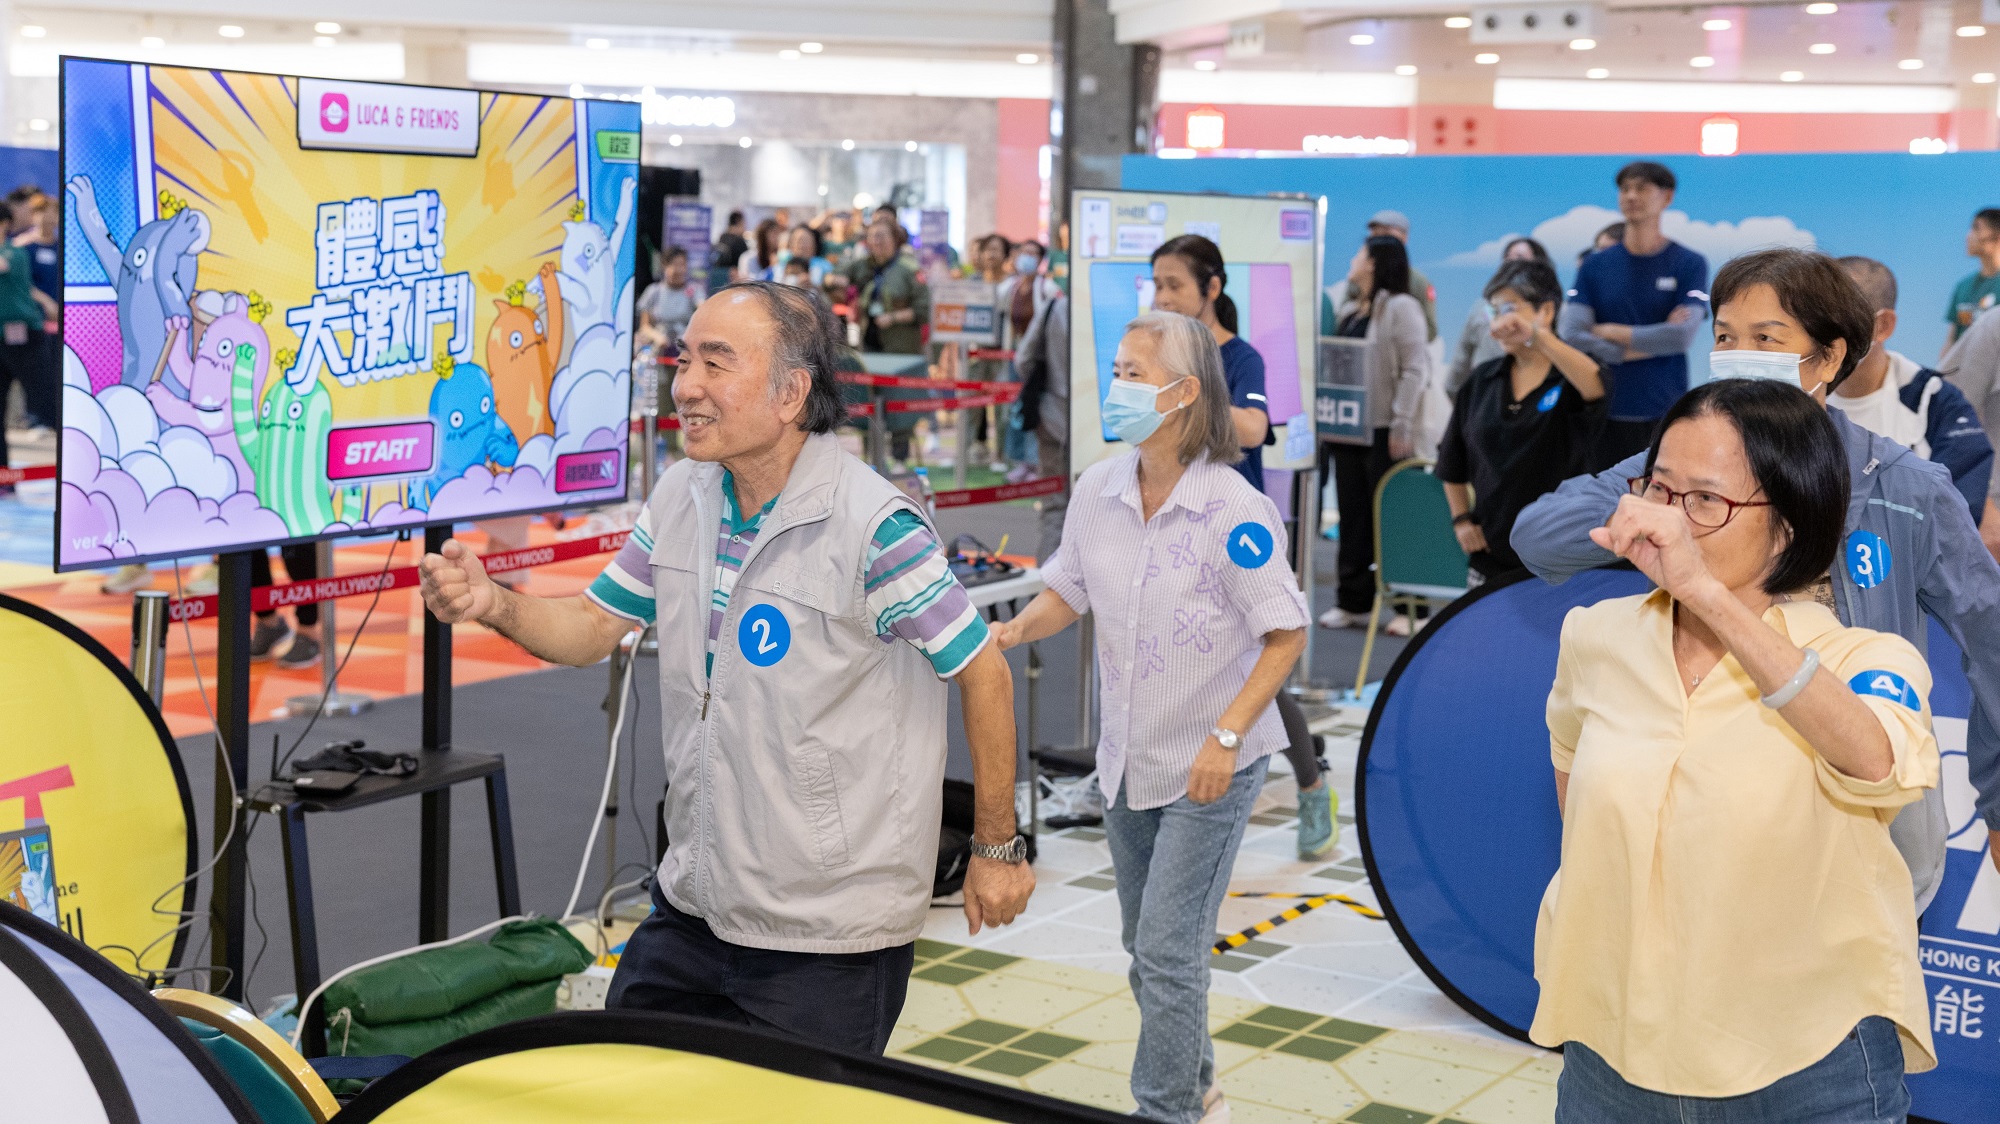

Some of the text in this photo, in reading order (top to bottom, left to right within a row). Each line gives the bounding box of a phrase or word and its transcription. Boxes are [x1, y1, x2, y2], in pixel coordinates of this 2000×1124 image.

[357, 104, 459, 131] LUCA & FRIENDS
[315, 190, 443, 291] 體感
[344, 437, 419, 465] START
[72, 535, 98, 550] ver
[1239, 533, 1261, 556] 1
[486, 547, 555, 571] HOLLYWOOD
[1856, 543, 1873, 575] 3
[269, 572, 395, 606] PLAZA HOLLYWOOD
[752, 618, 778, 655] 2
[1870, 675, 1902, 697] 4
[1919, 946, 1981, 973] HONG
[1934, 984, 1985, 1039] 能
